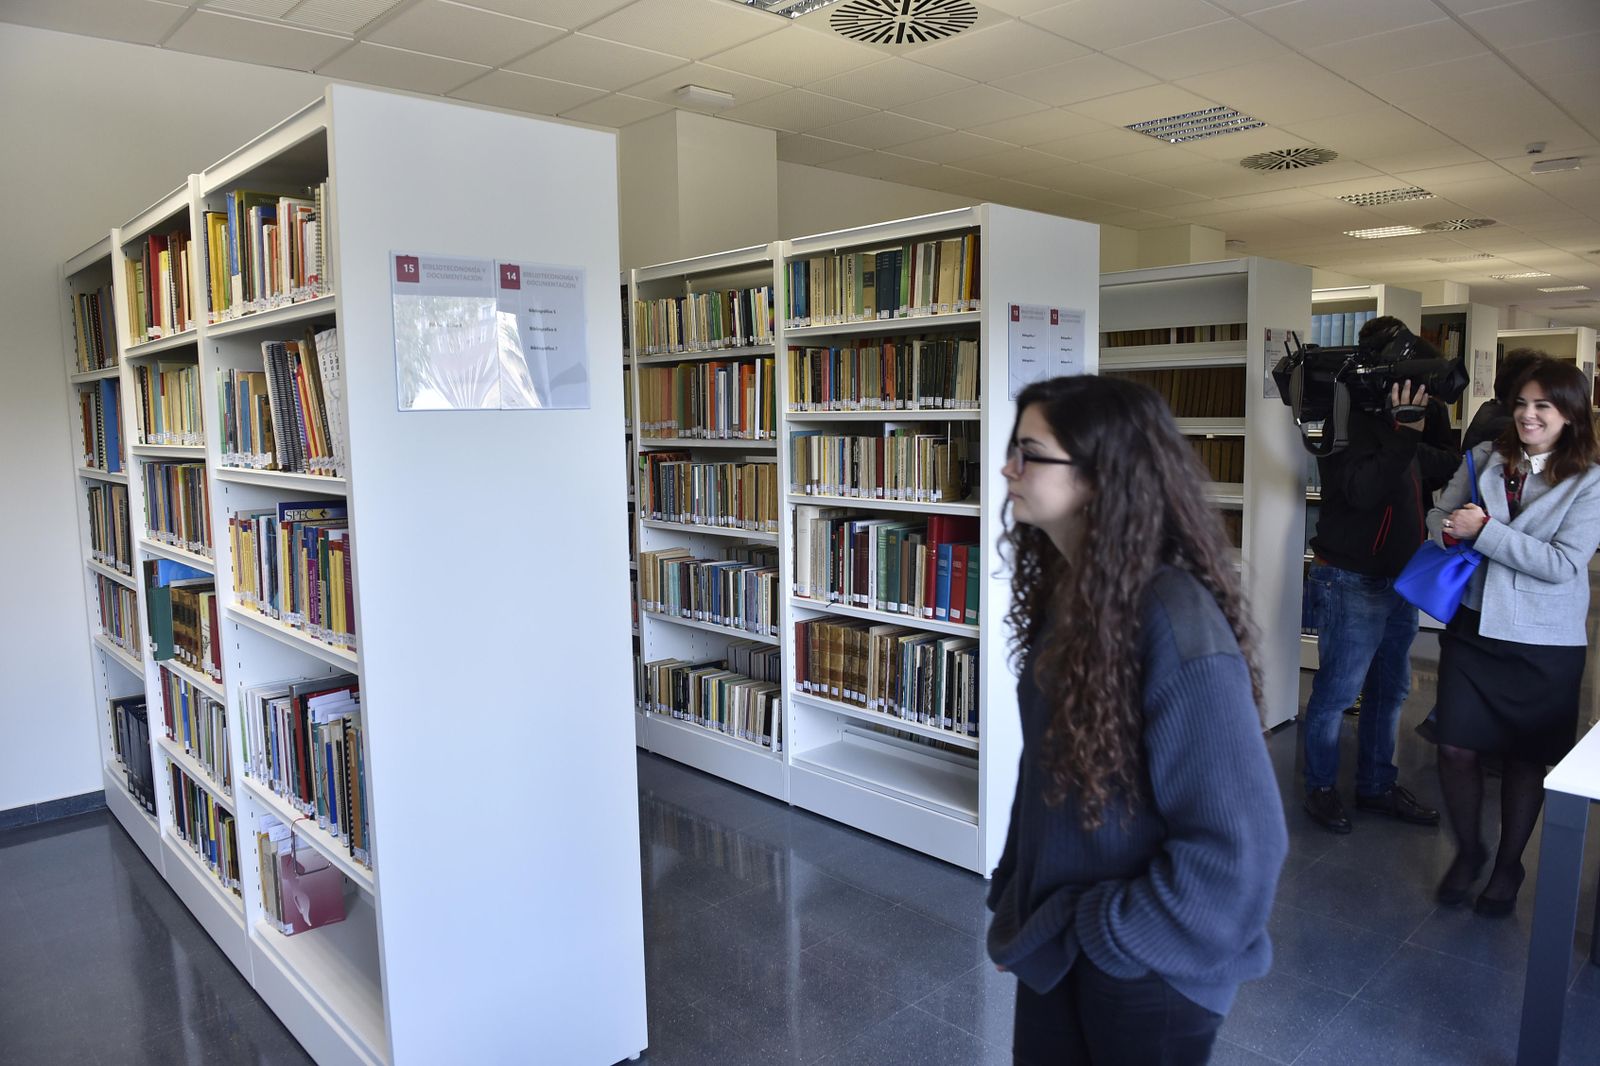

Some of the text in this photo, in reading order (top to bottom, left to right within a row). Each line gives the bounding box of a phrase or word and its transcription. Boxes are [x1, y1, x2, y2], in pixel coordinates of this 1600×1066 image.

[403, 264, 415, 273] 15
[506, 271, 517, 280] 14
[285, 509, 314, 521] SPEC
